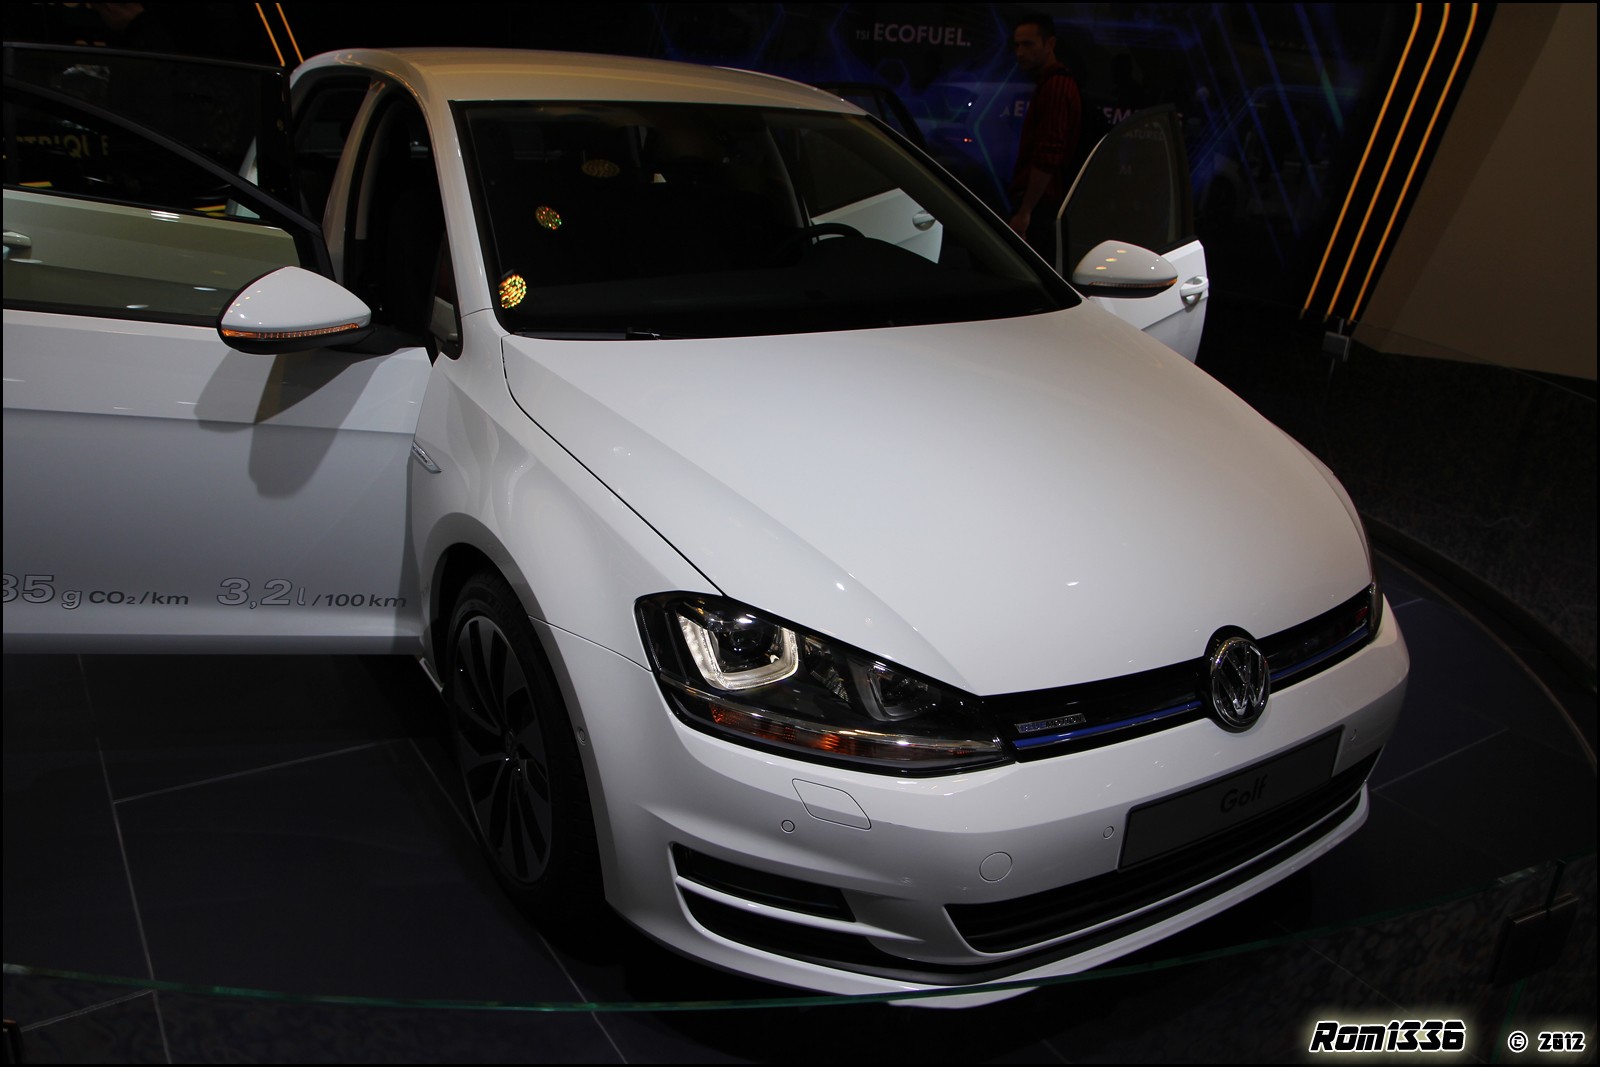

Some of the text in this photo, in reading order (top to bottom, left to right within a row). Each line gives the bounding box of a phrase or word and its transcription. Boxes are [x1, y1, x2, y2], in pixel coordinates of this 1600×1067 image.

[856, 22, 972, 47] TSI ECOFUEL.
[1220, 774, 1268, 813] Golf
